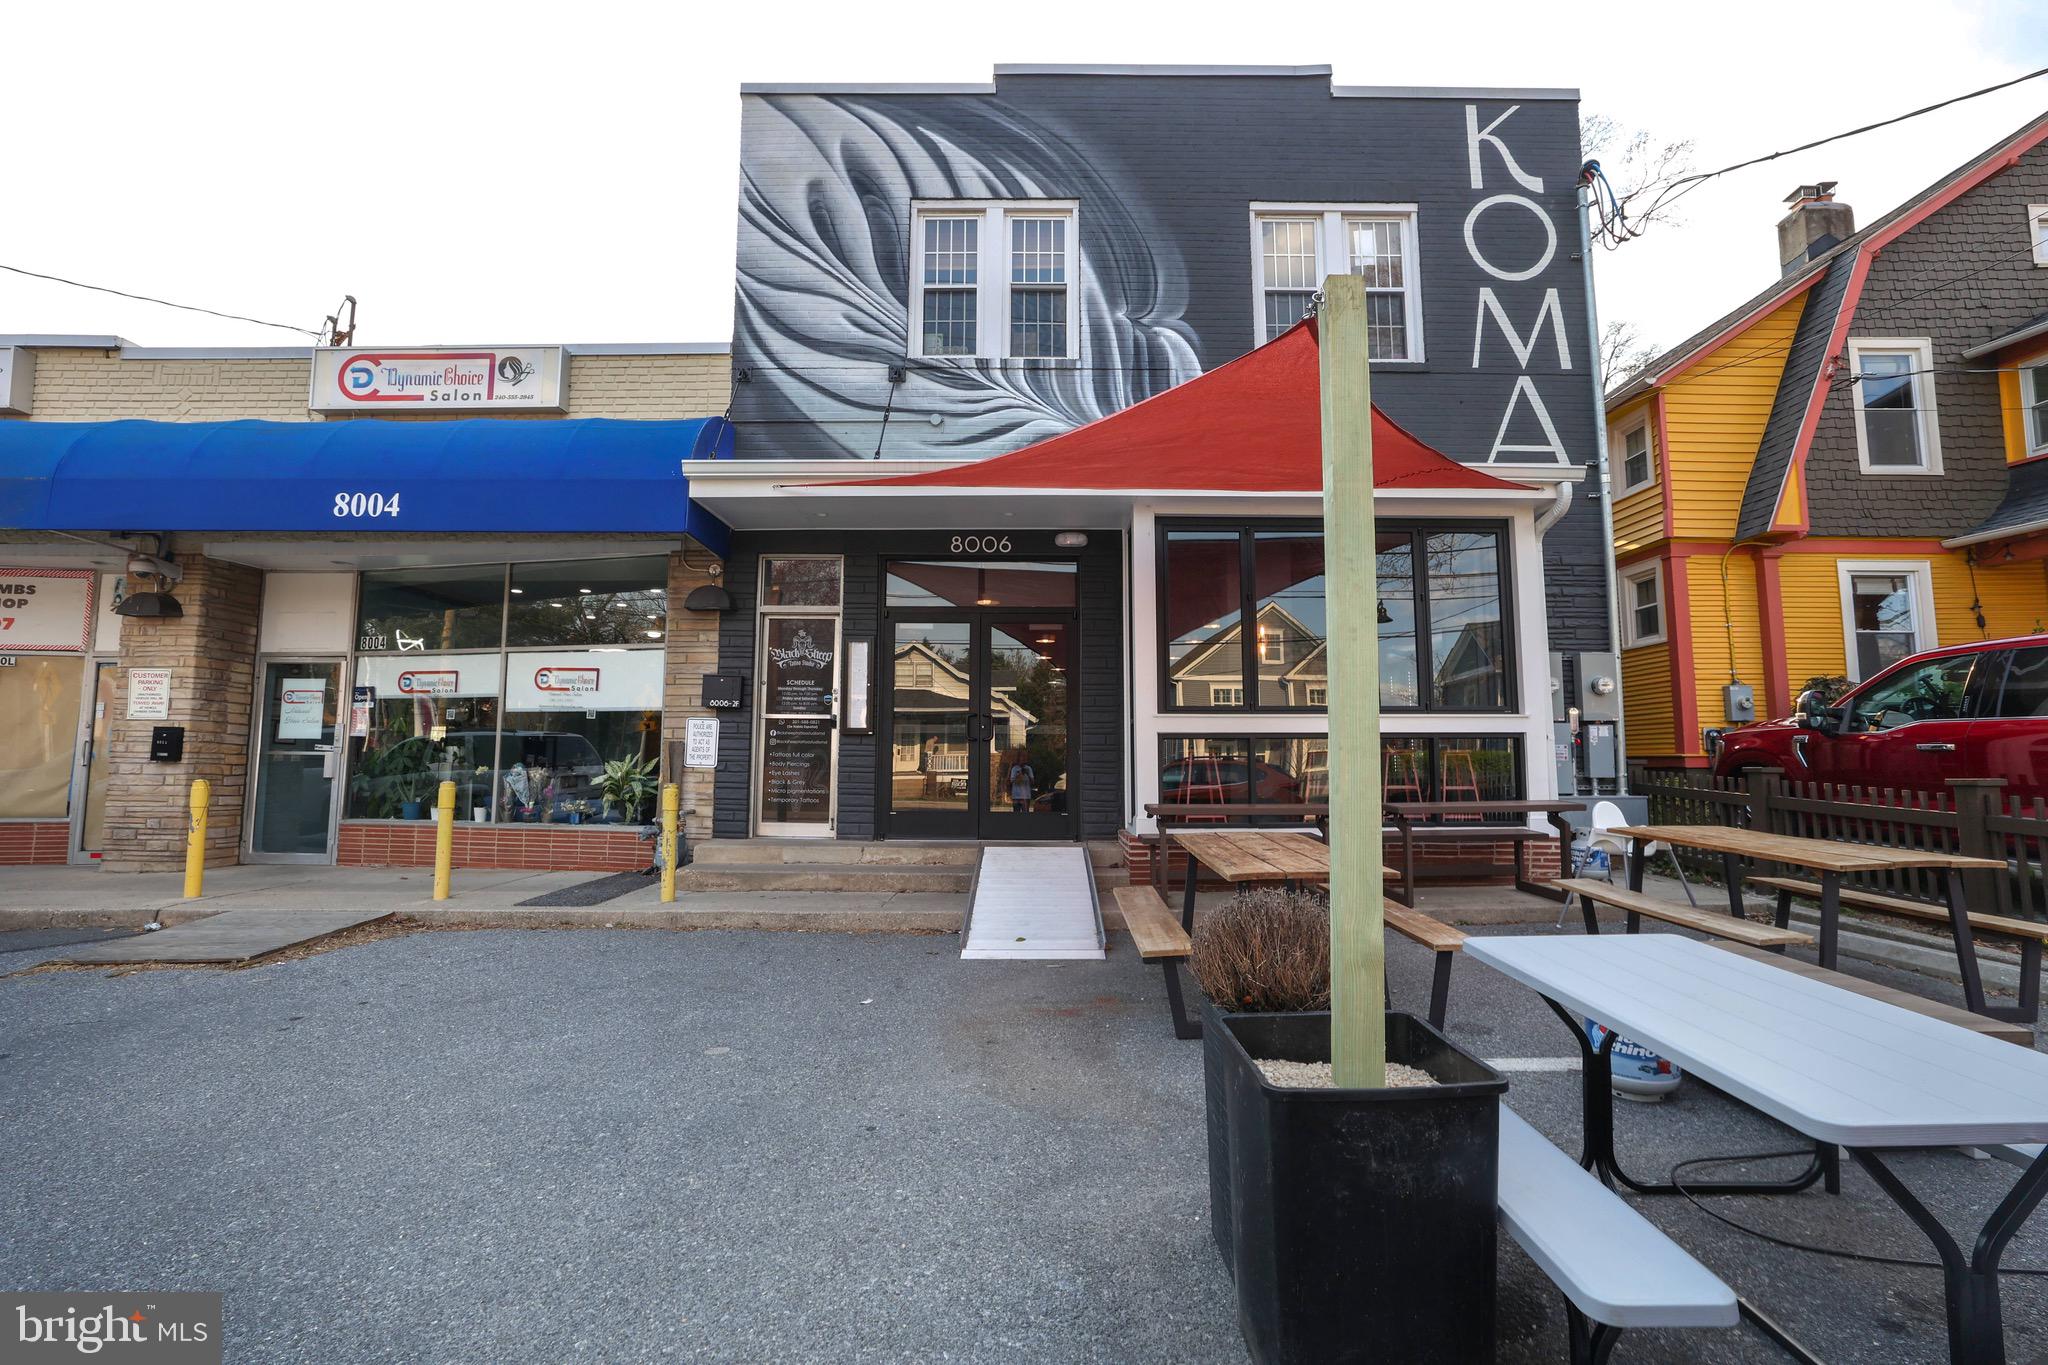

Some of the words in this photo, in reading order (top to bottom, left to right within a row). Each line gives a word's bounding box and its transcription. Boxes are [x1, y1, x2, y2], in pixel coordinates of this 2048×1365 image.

[1464, 104, 1573, 465] KOMA
[381, 367, 443, 392] Dynamic
[443, 364, 484, 386] Choice
[430, 389, 482, 401] Salon
[333, 492, 400, 517] 8004
[950, 536, 1012, 553] 8006
[0, 584, 37, 595] MBS
[0, 598, 29, 609] OP
[0, 617, 16, 630] 7
[361, 637, 386, 649] 8004
[770, 648, 800, 661] Black
[804, 649, 833, 662] Sheep
[1611, 1041, 1657, 1057] hino
